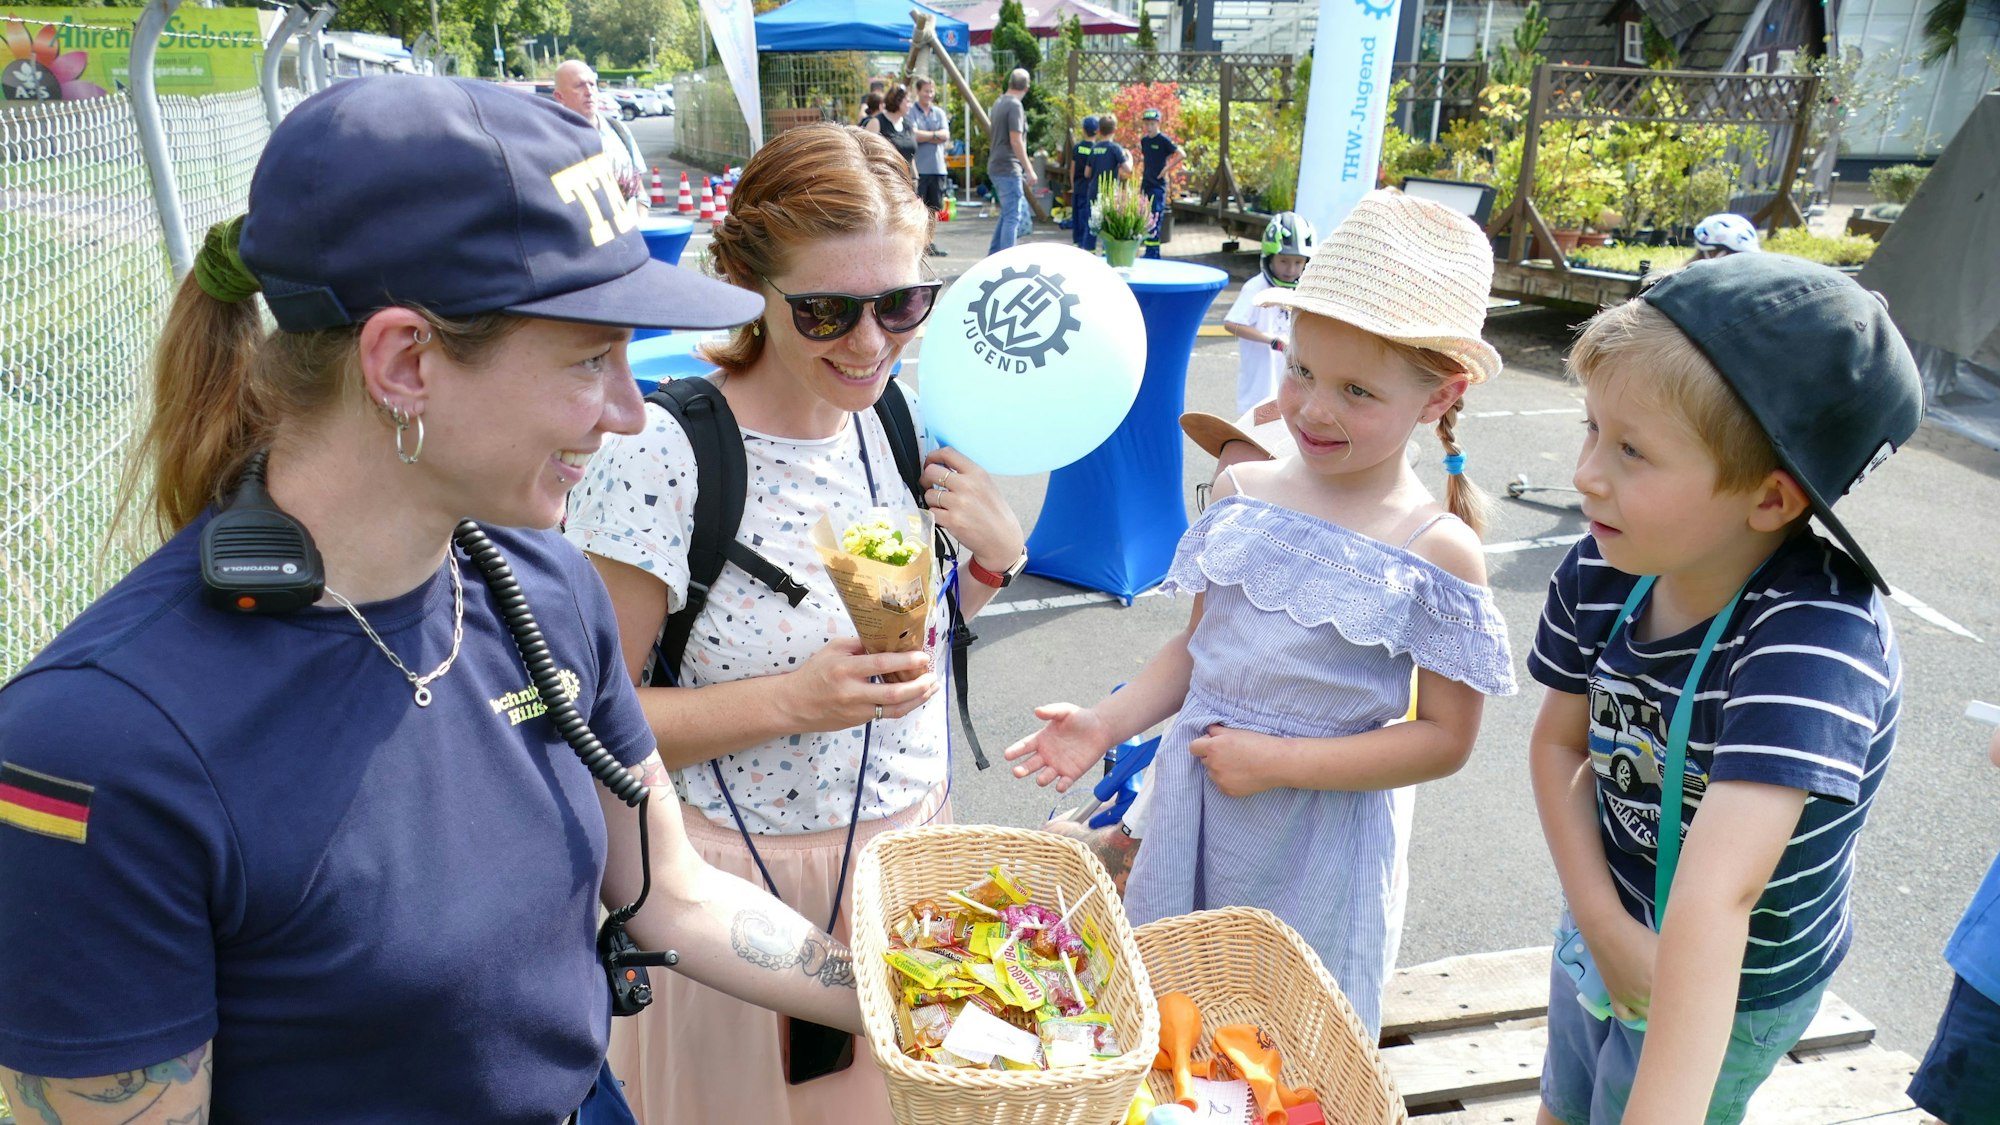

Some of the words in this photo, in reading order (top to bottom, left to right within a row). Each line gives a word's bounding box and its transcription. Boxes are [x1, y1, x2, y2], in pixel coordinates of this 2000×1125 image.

[50, 15, 130, 48] Ahren
[159, 16, 254, 48] Sieberz
[1342, 36, 1376, 182] THW-Jugend
[963, 317, 1028, 374] JUGEND
[508, 702, 548, 726] Hilfs
[1006, 964, 1042, 1000] HARIBO
